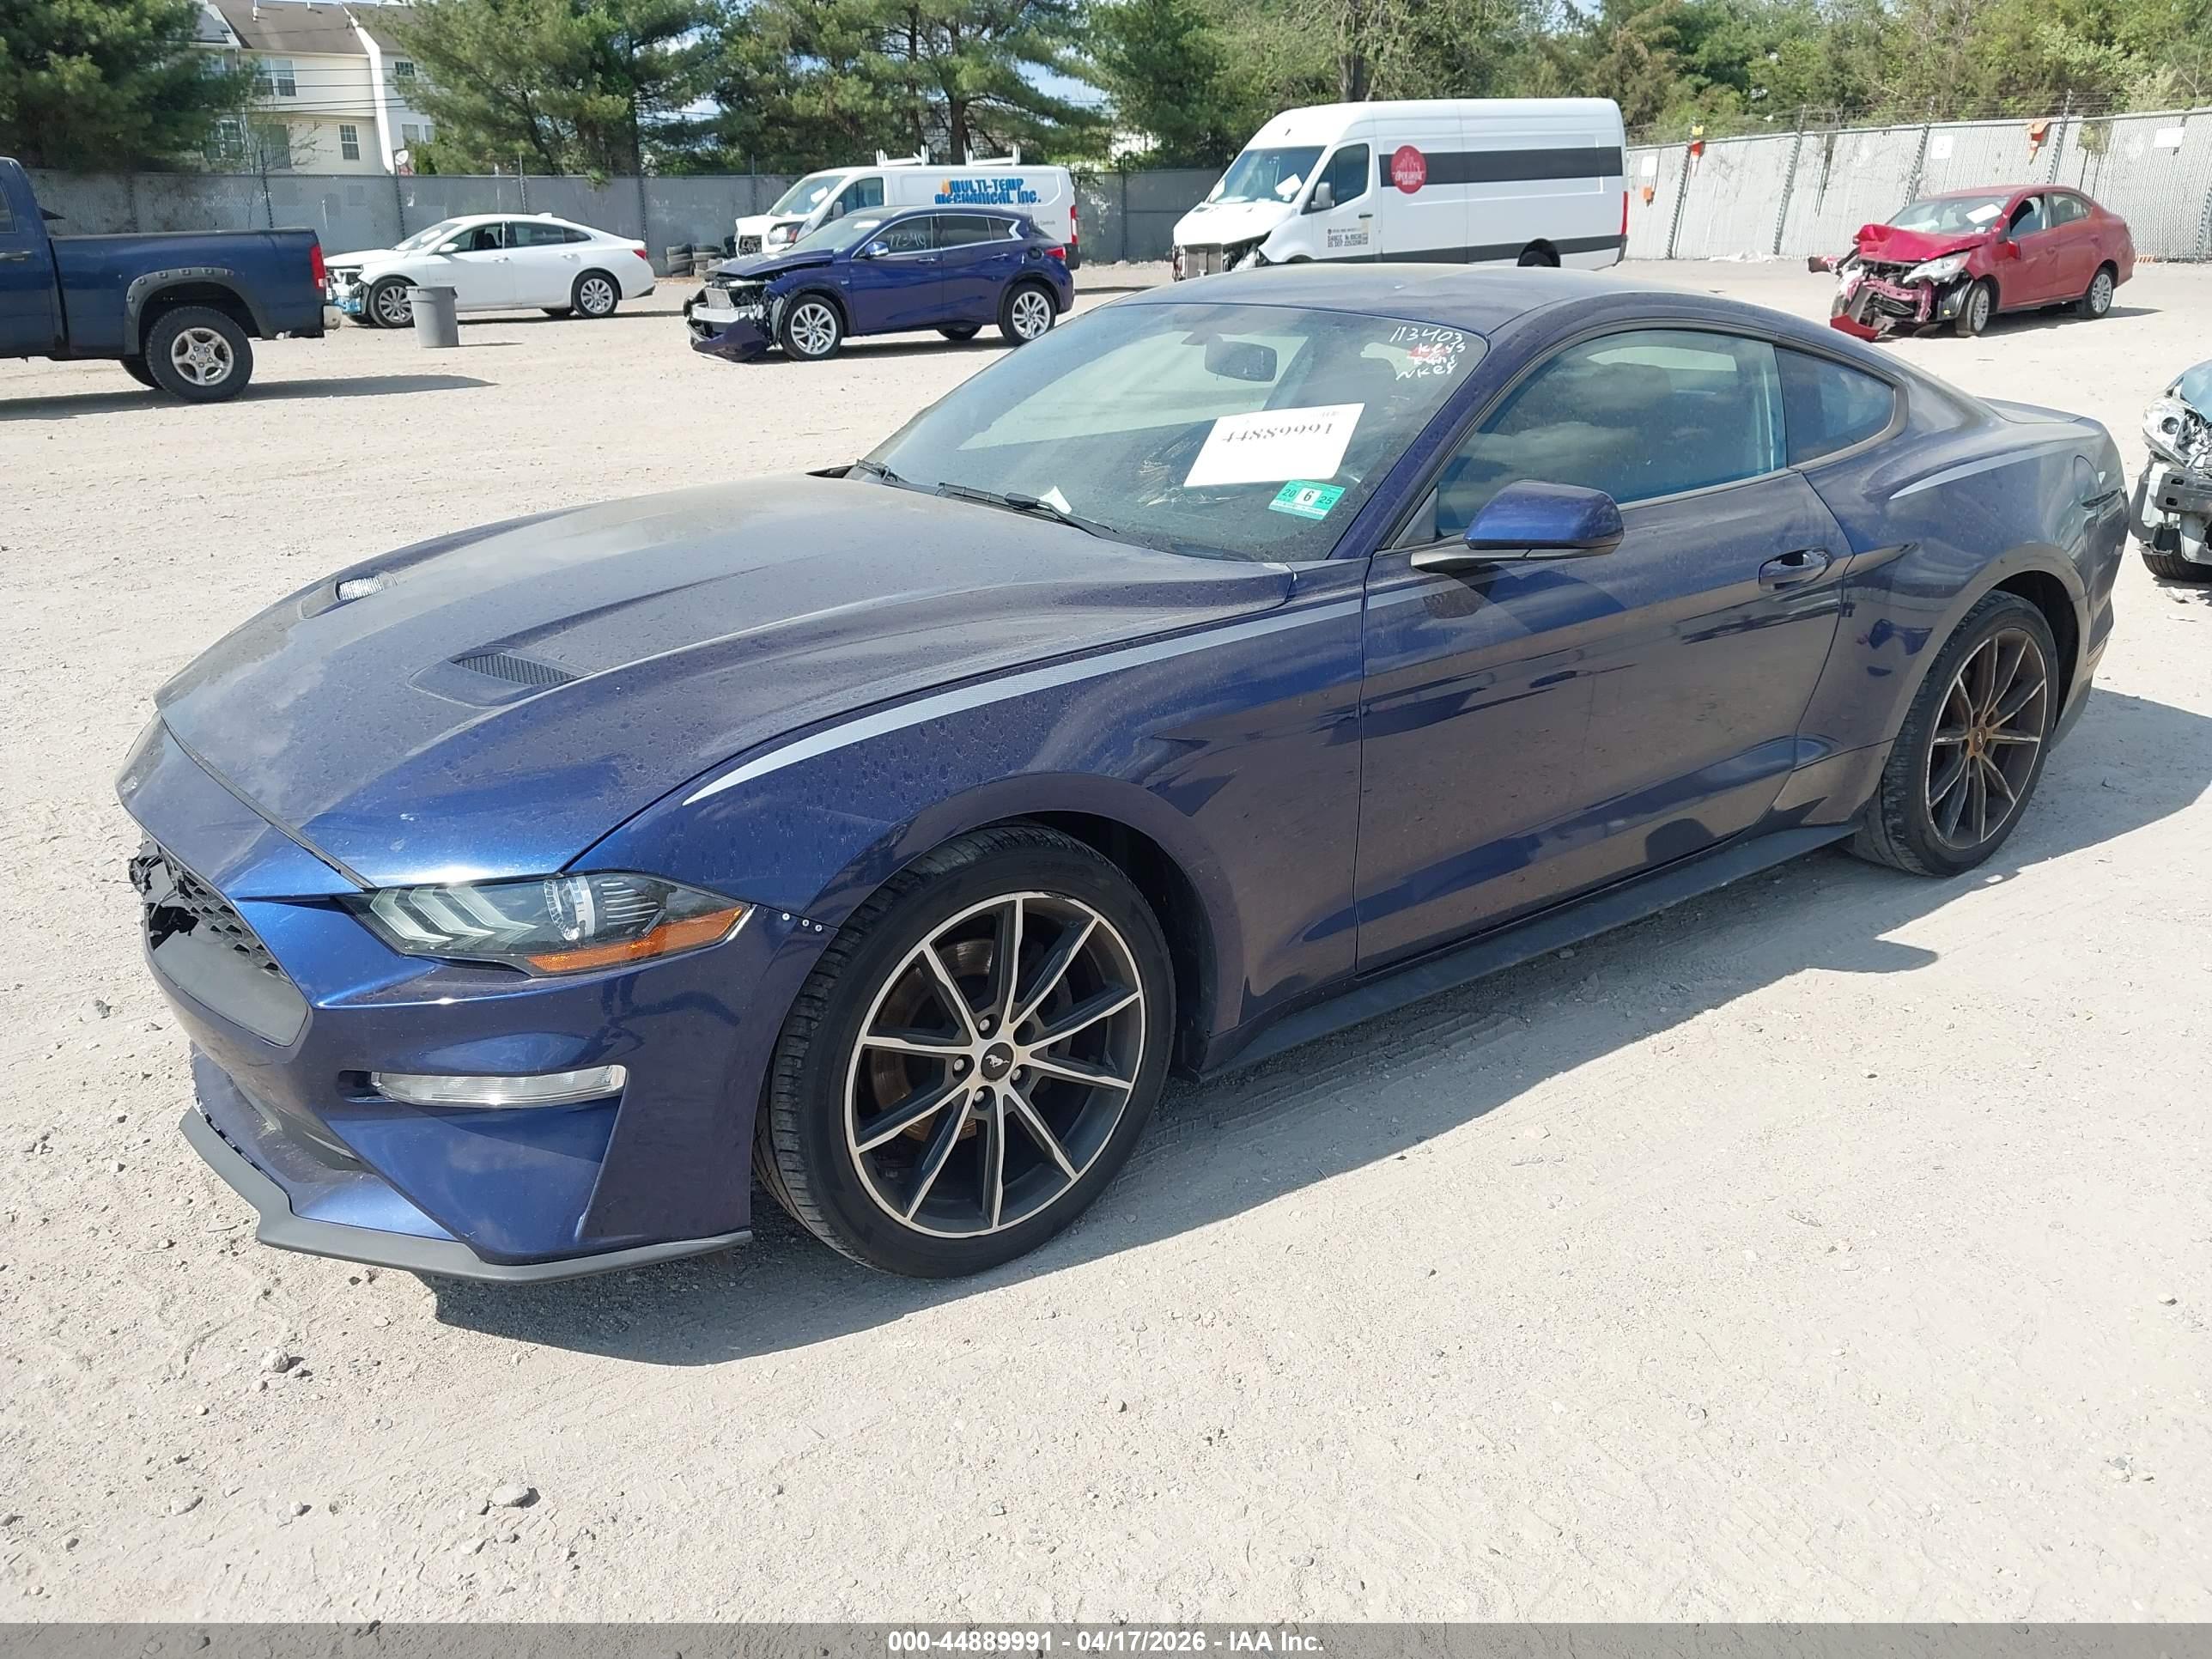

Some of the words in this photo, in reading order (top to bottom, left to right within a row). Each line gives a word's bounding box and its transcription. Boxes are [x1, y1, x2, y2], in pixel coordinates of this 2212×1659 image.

[949, 179, 1024, 194] MULTI-TEMP
[1282, 489, 1297, 498] 20
[1304, 490, 1315, 501] 6
[1318, 495, 1334, 505] 25
